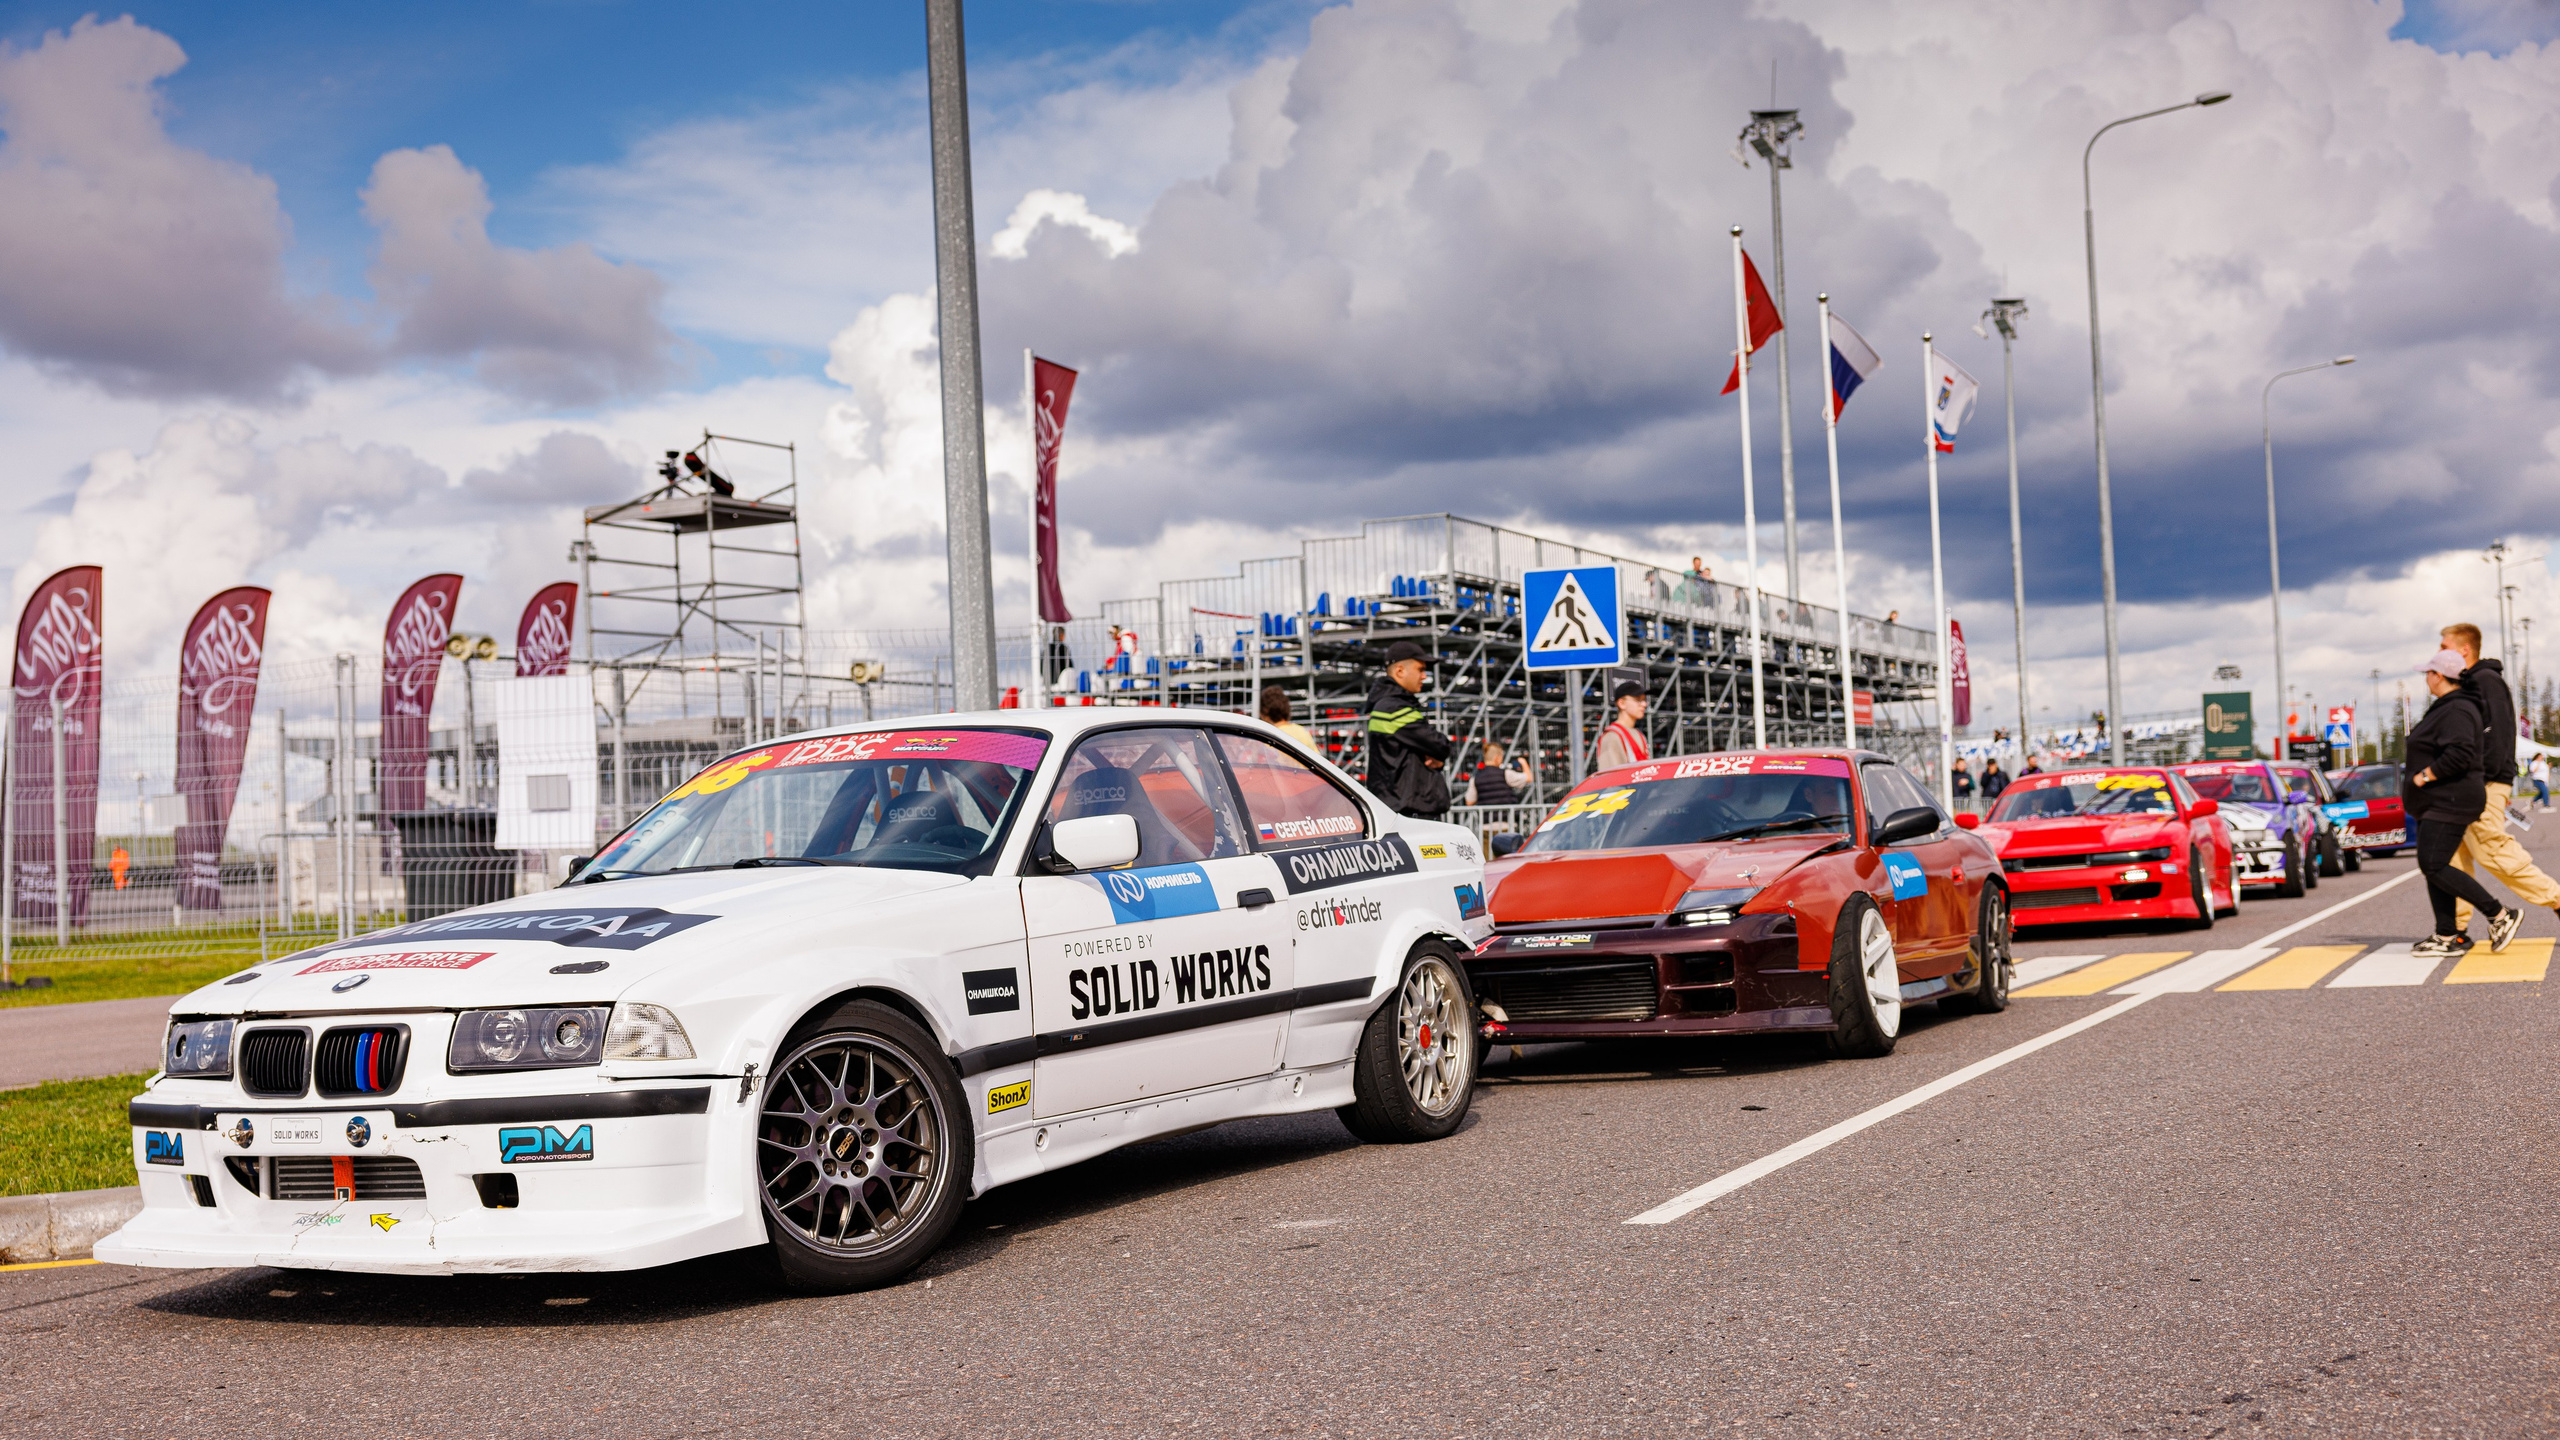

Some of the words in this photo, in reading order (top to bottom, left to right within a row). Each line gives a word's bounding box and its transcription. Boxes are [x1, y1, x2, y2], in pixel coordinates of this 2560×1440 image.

[848, 733, 894, 741] DRIVE
[780, 738, 887, 763] IDDC
[807, 753, 873, 764] CHALLENGE
[1674, 760, 1753, 778] IDDC
[1074, 786, 1126, 805] sparco
[888, 805, 936, 823] sparco
[1545, 788, 1637, 825] 34
[1275, 816, 1320, 839] СЕРГЕЙ
[1319, 815, 1357, 834] ПОПОВ
[1421, 847, 1445, 857] SHONX
[1289, 841, 1404, 884] ОНЛИШКОДА
[1144, 872, 1202, 889] НОРНИКЕЛЬ
[1064, 936, 1132, 958] POWERED
[1137, 934, 1154, 950] BY
[1513, 934, 1591, 943] EVOLUTION
[334, 954, 406, 967] IGORA
[408, 952, 476, 962] DRIVE
[369, 959, 464, 969] CHALLENGE
[1069, 959, 1160, 1021] SOLID
[1170, 944, 1271, 1004] WORKS
[967, 985, 1015, 1000] ОНЛИШКОДА
[990, 1085, 1028, 1109] ShonX
[274, 1131, 292, 1140] SOLID
[295, 1131, 319, 1139] WORKS
[836, 1133, 855, 1158] BBS
